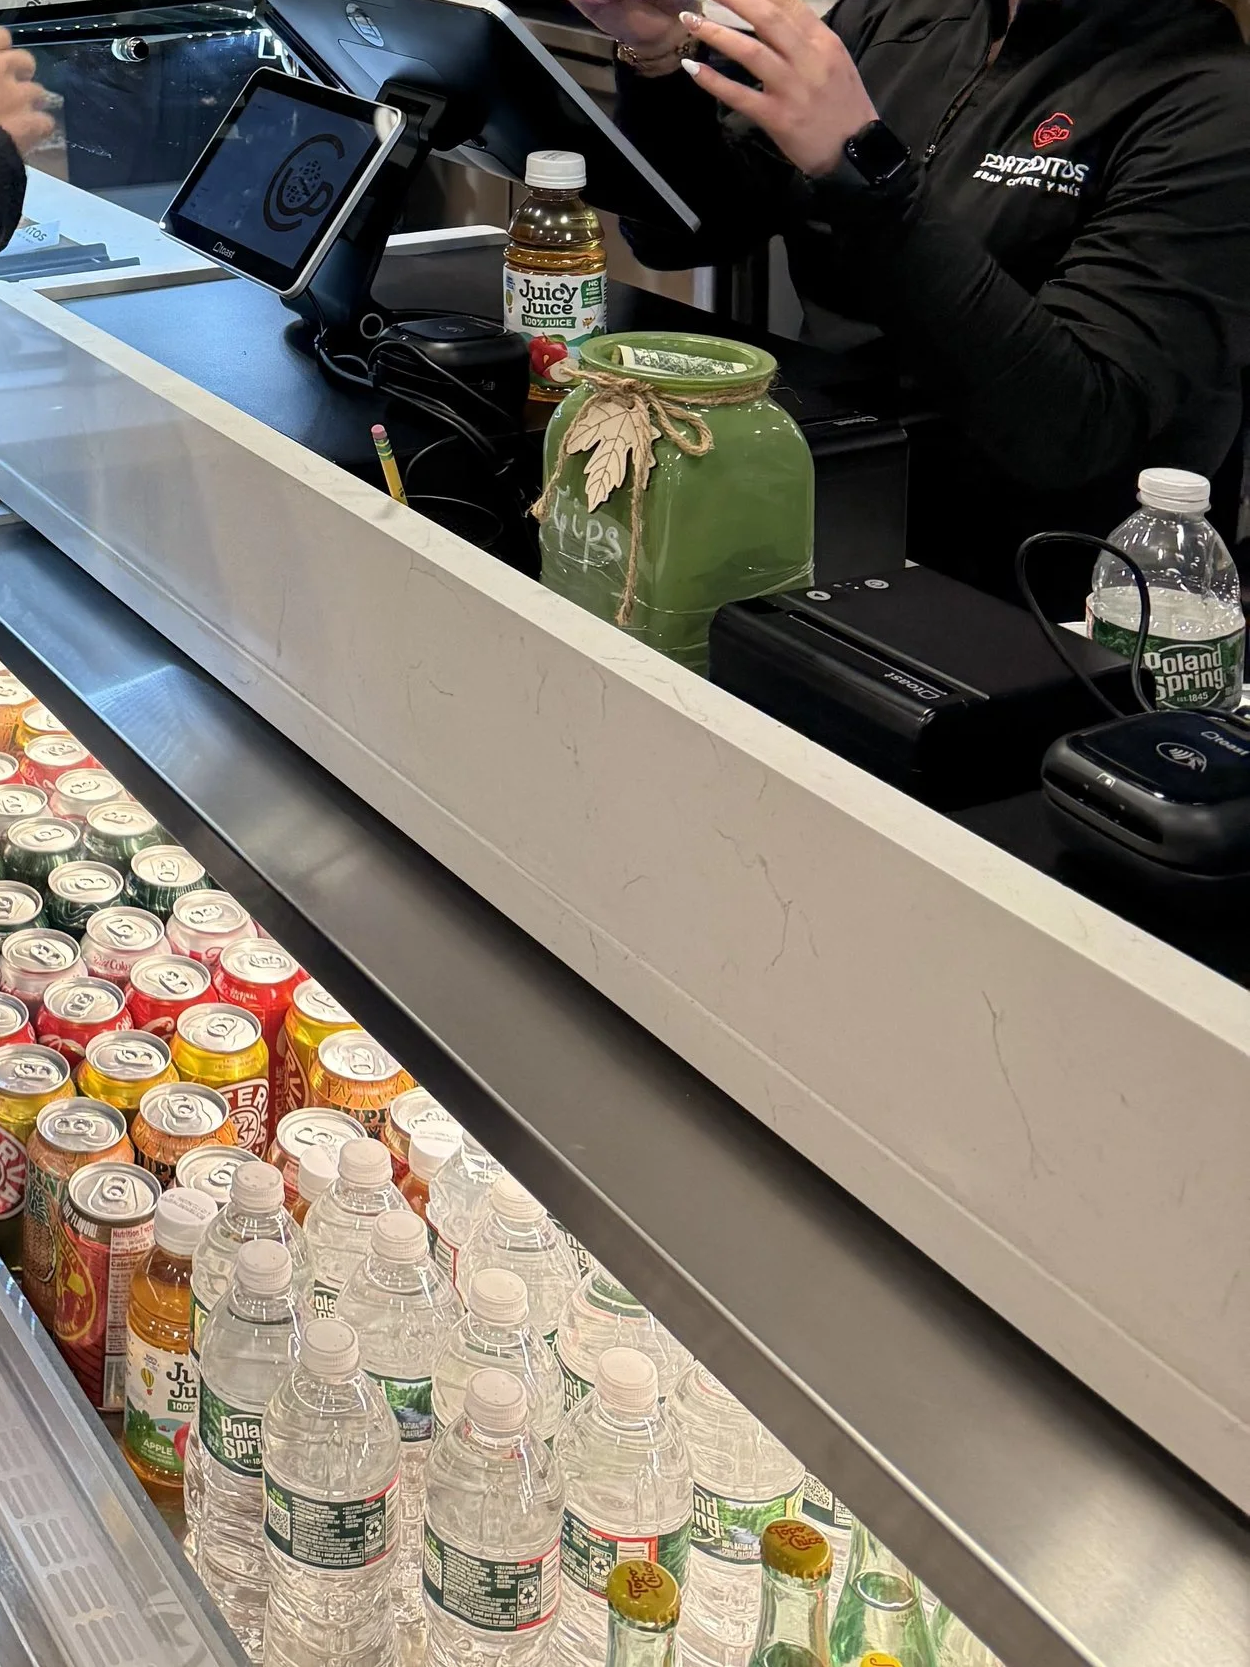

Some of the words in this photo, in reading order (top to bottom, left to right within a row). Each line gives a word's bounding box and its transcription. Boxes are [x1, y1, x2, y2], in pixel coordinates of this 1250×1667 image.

[219, 241, 236, 259] toast
[519, 279, 578, 304] Juicy
[523, 298, 573, 315] Juice
[524, 317, 545, 327] 100%
[545, 317, 573, 327] JUICE
[1143, 643, 1222, 674] Poland
[1155, 668, 1225, 700] Spring
[1189, 692, 1209, 702] 1845
[113, 1229, 139, 1238] Nutrition
[143, 1439, 173, 1455] APPLE
